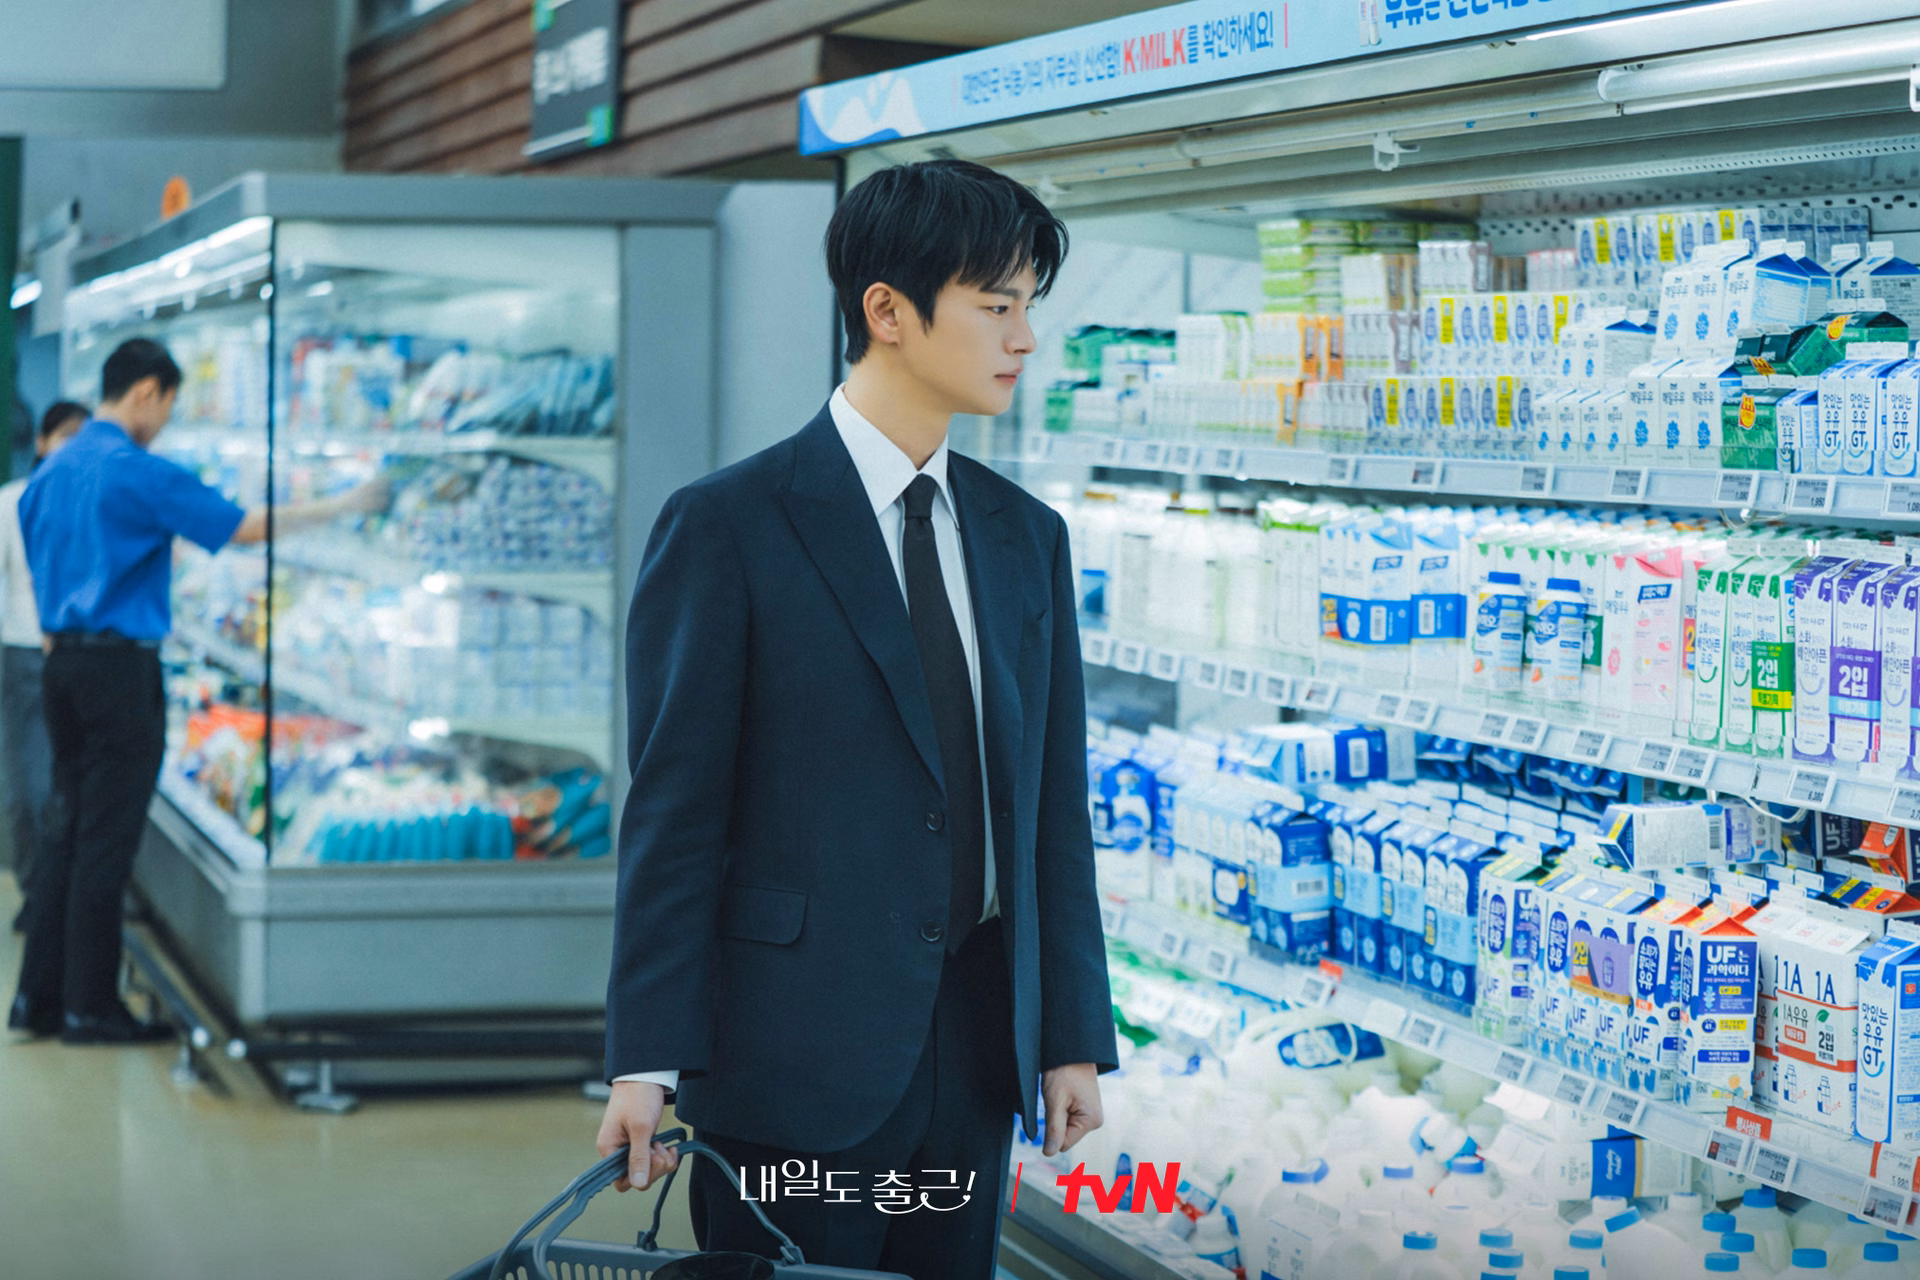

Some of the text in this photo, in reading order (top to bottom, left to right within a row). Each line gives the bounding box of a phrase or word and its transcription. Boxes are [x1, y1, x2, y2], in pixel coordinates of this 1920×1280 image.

[1202, 10, 1274, 60] 확인하세요!
[1825, 430, 1839, 448] GT
[1851, 430, 1866, 447] GT
[1893, 431, 1908, 449] GT
[1757, 658, 1778, 689] 2입
[1838, 665, 1868, 698] 2입
[1706, 964, 1749, 977] 과학이다
[1784, 961, 1804, 994] 1A
[1815, 971, 1837, 1005] 1A
[1573, 1005, 1587, 1025] UF
[1600, 1014, 1614, 1034] UF
[1861, 1003, 1889, 1026] 맛있는
[1634, 1024, 1650, 1044] UF
[1818, 1031, 1834, 1052] 2입
[1863, 1023, 1885, 1047] 우유
[1862, 1046, 1883, 1067] GT
[1736, 1116, 1762, 1138] 행사상품
